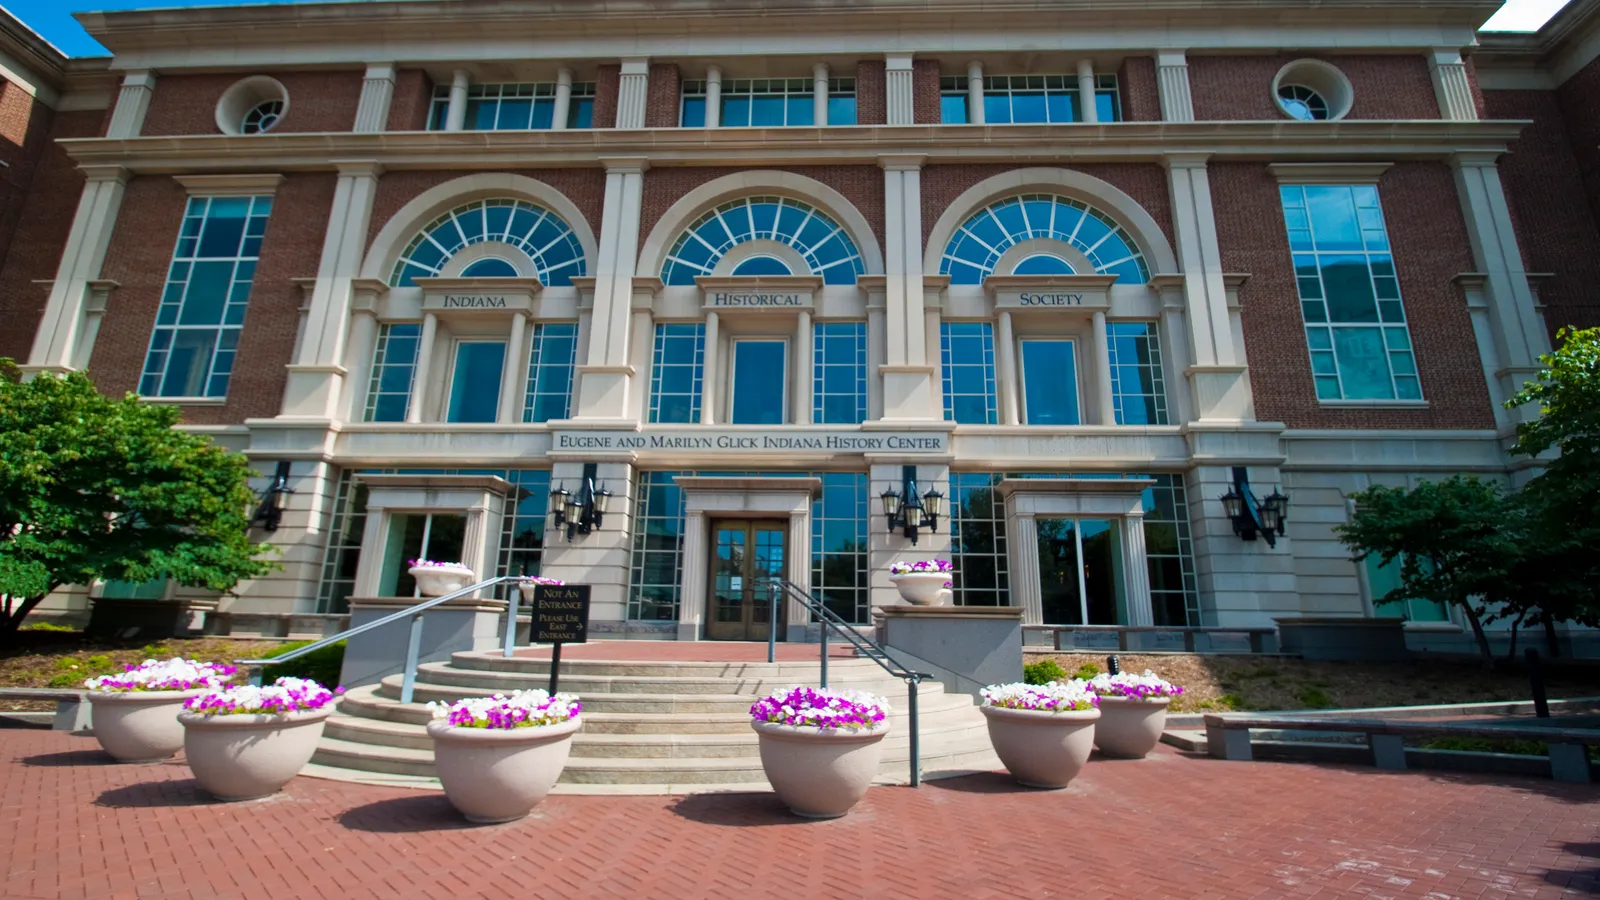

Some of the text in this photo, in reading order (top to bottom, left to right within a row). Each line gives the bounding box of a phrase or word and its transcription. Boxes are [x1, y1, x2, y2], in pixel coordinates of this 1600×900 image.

[443, 295, 507, 307] INDIANA
[715, 293, 802, 306] HISTORICAL
[1020, 292, 1083, 305] SOCIETY
[559, 435, 941, 448] EUGENE AND MARILYN GLICK INDIANA HISTORY CENTER
[543, 589, 579, 598] NOT AN
[538, 600, 583, 609] ENTRANCE
[539, 614, 579, 622] PLEASE USE
[549, 622, 567, 630] EAST
[539, 631, 577, 639] ENTRANCE
